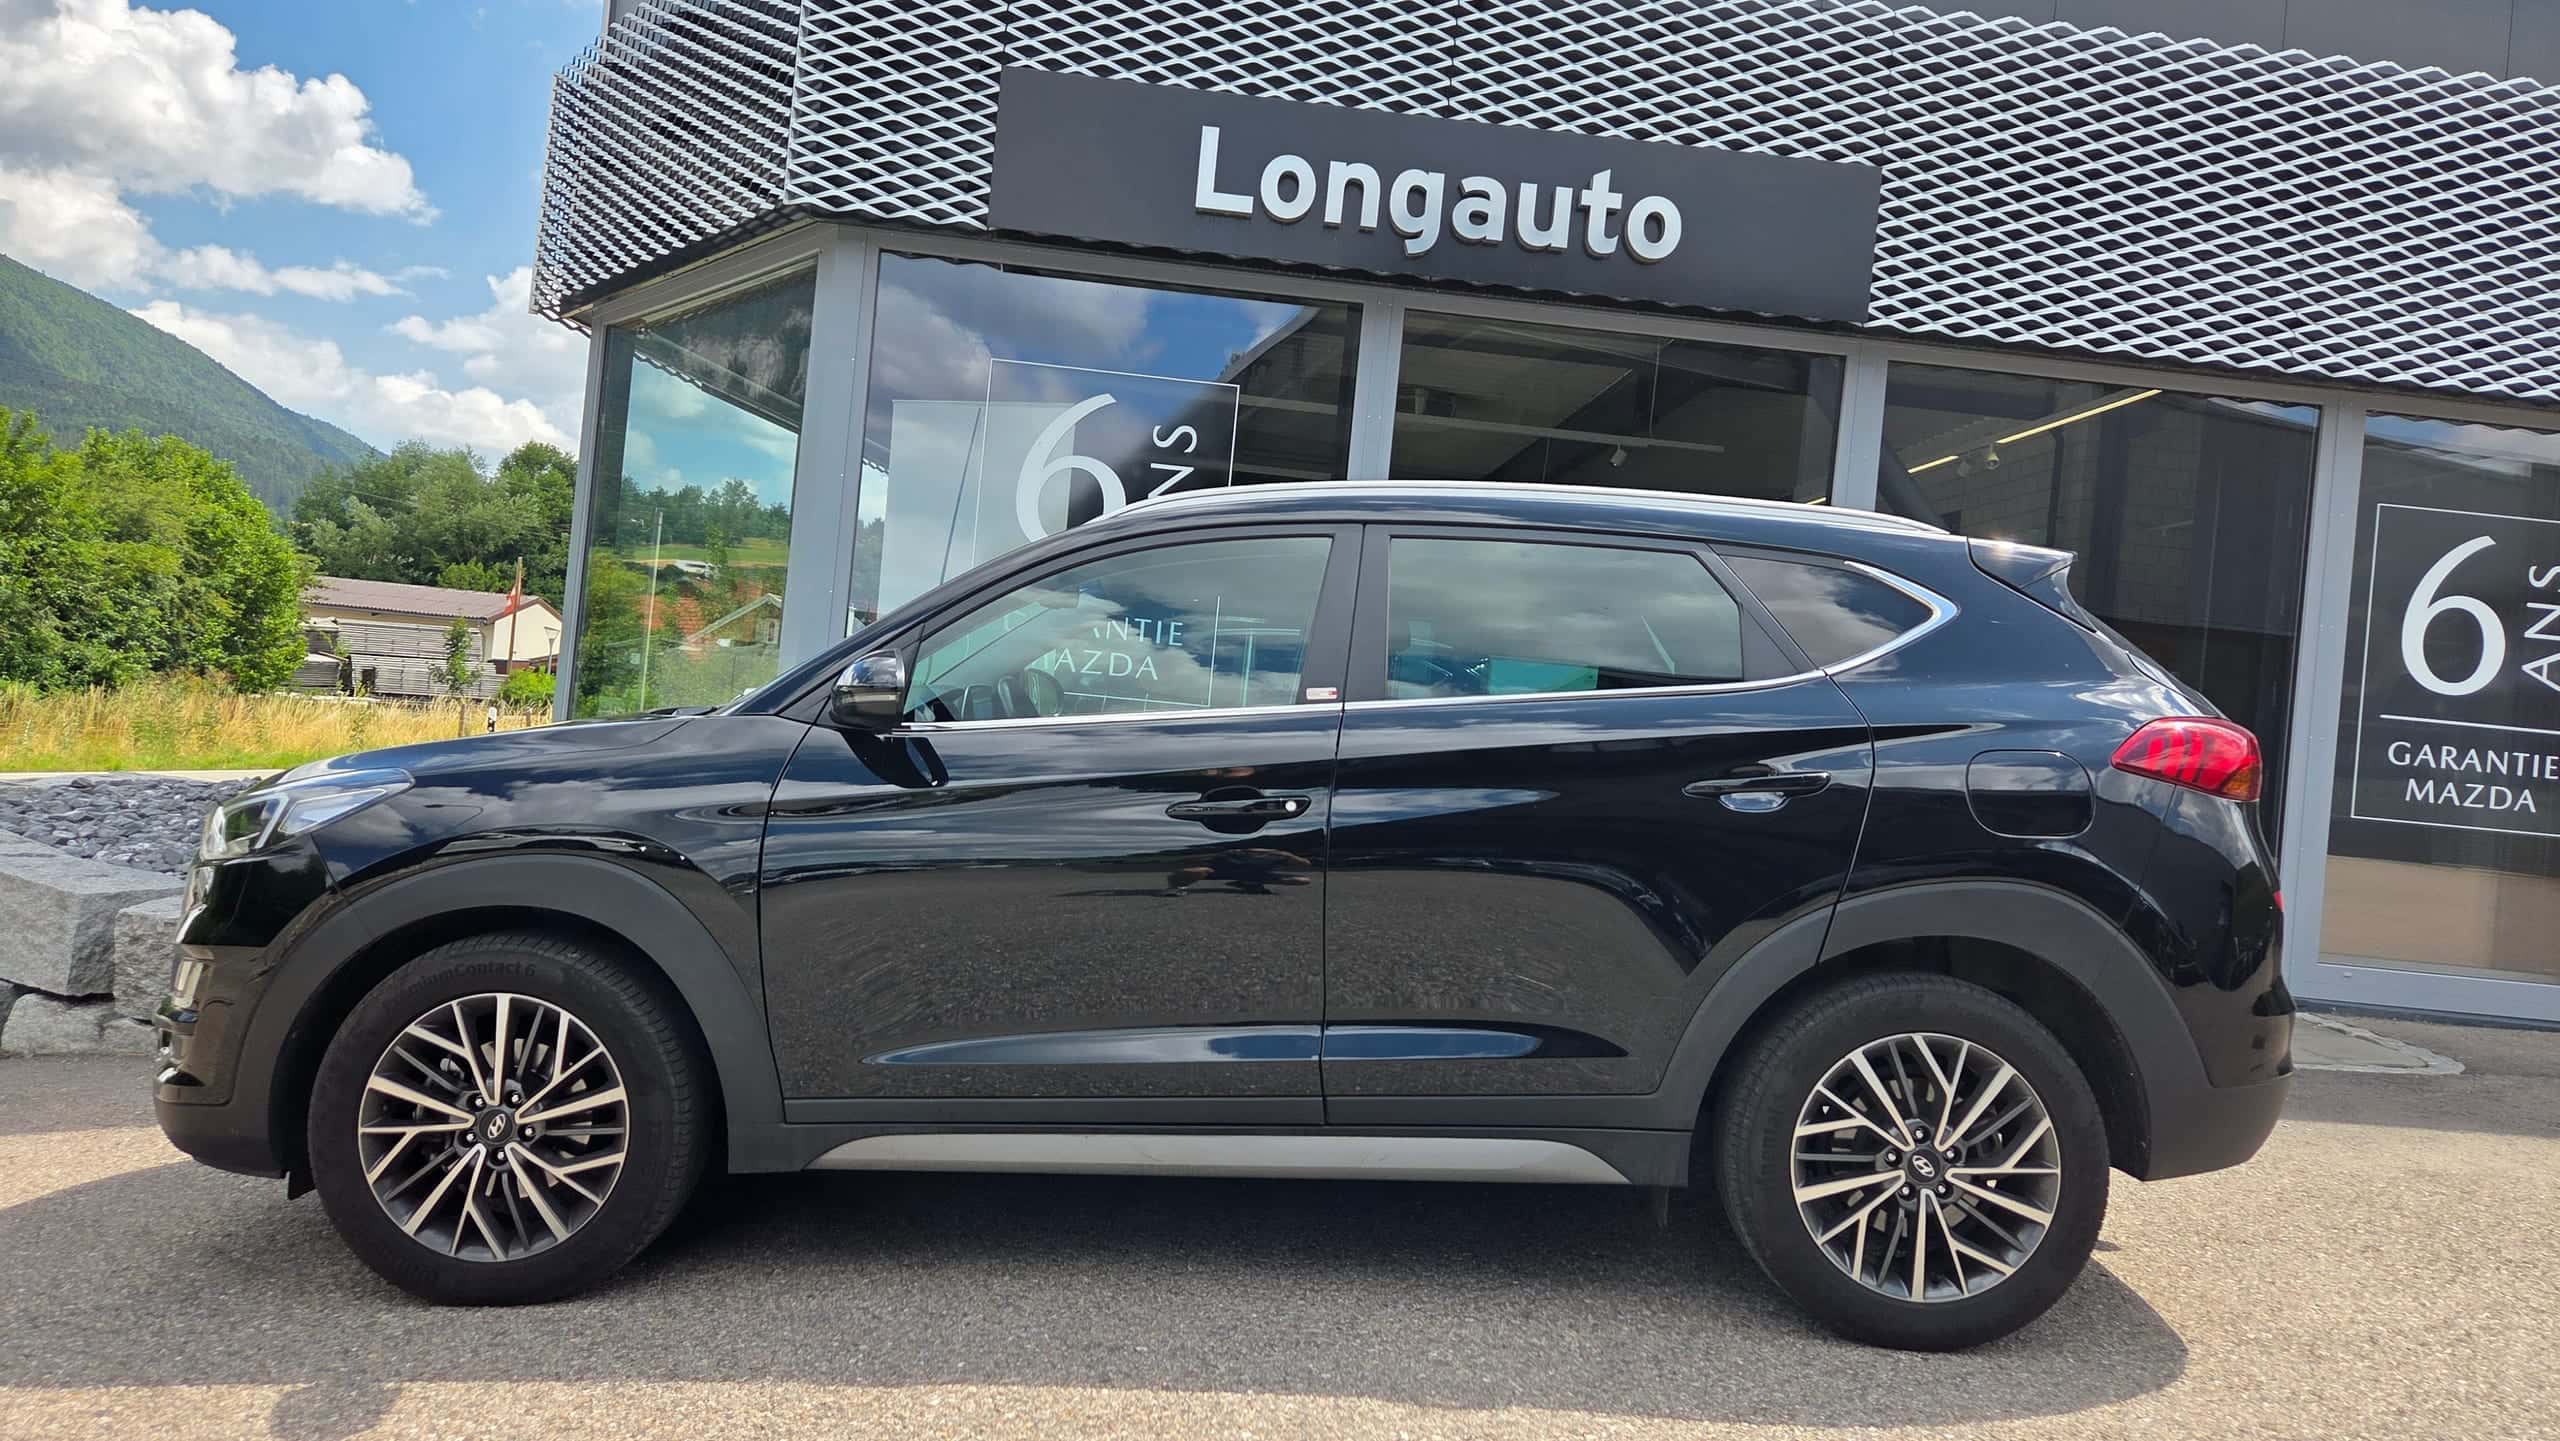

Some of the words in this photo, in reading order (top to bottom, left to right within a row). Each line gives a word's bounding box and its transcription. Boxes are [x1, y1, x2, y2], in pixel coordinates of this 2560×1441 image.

[1195, 124, 1683, 263] Longauto
[1016, 393, 1127, 542] 6
[1148, 425, 1198, 499] NS
[2402, 535, 2506, 696] 6
[2521, 565, 2560, 691] ANS
[2388, 741, 2560, 780] GARANTIE
[2405, 778, 2537, 813] MAZDA
